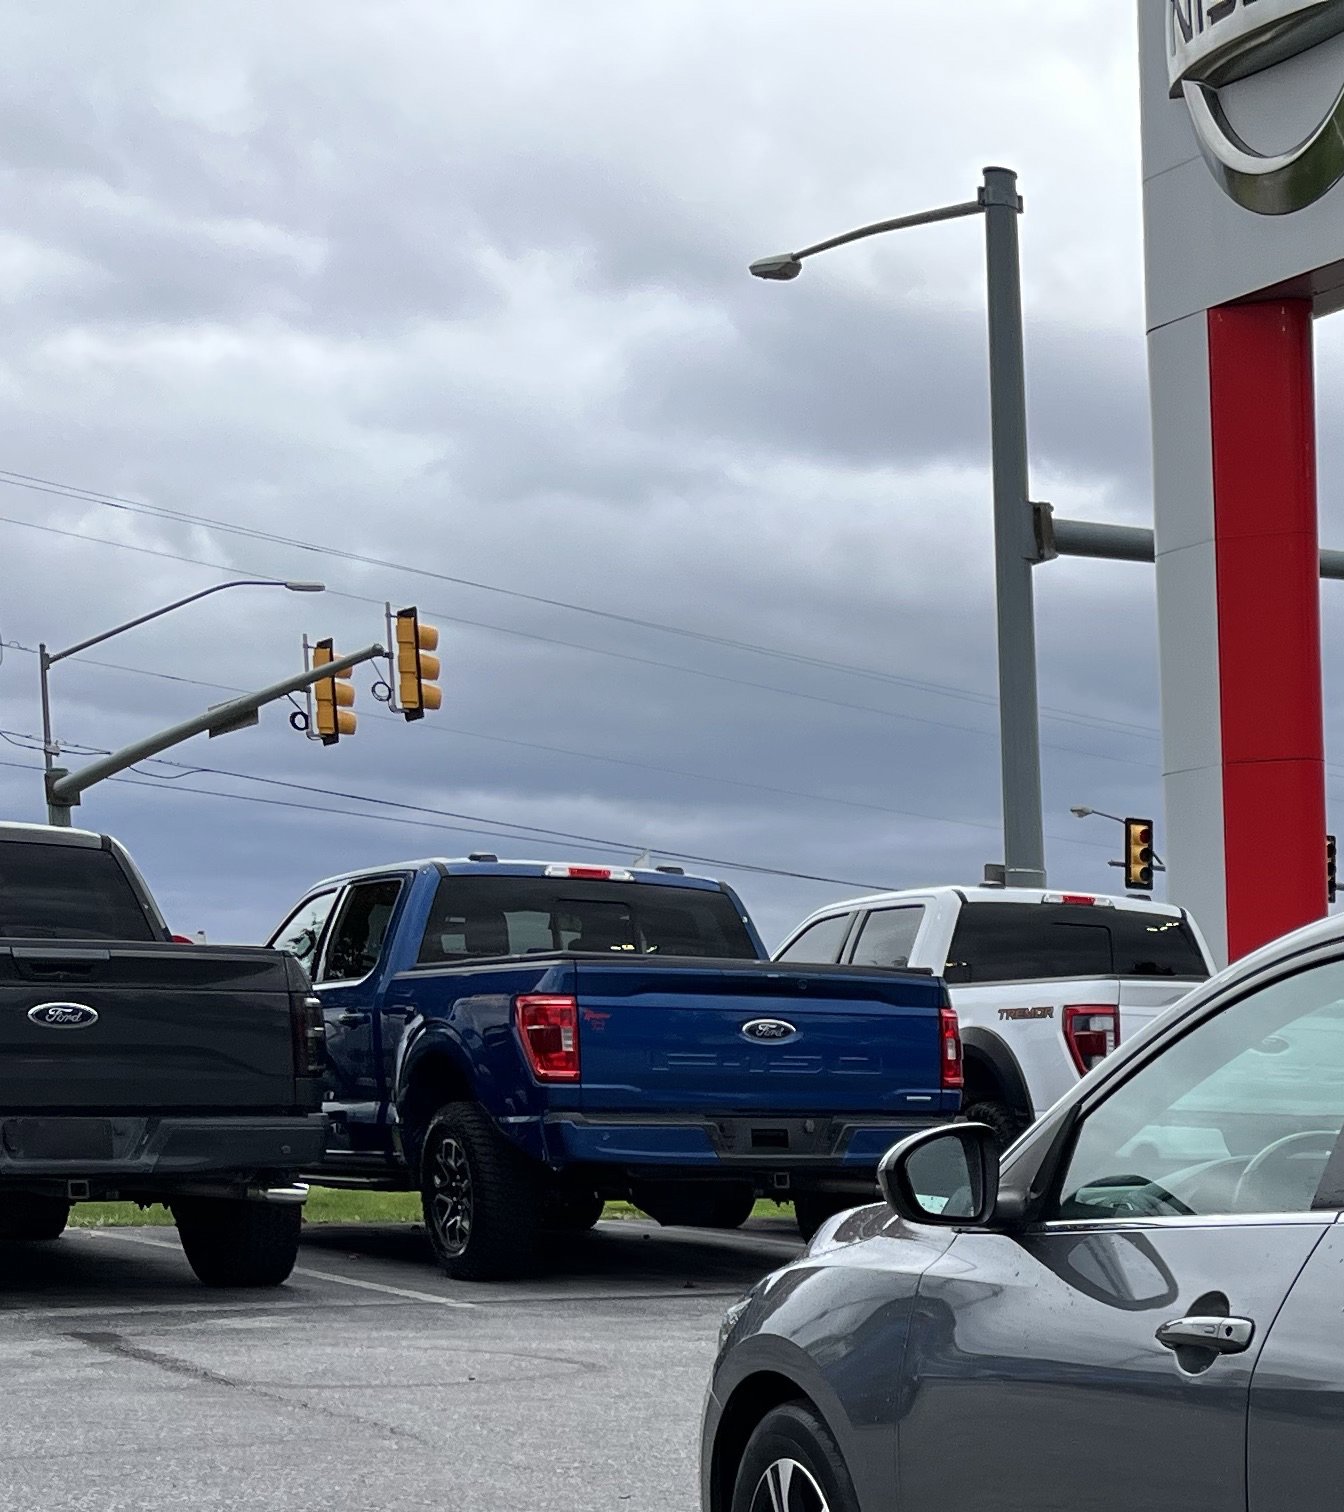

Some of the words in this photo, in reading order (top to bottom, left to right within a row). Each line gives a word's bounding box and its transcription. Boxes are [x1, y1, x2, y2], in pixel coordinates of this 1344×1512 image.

[45, 1007, 83, 1023] Ford
[998, 1007, 1054, 1020] TREMOR
[755, 1023, 785, 1037] Ford
